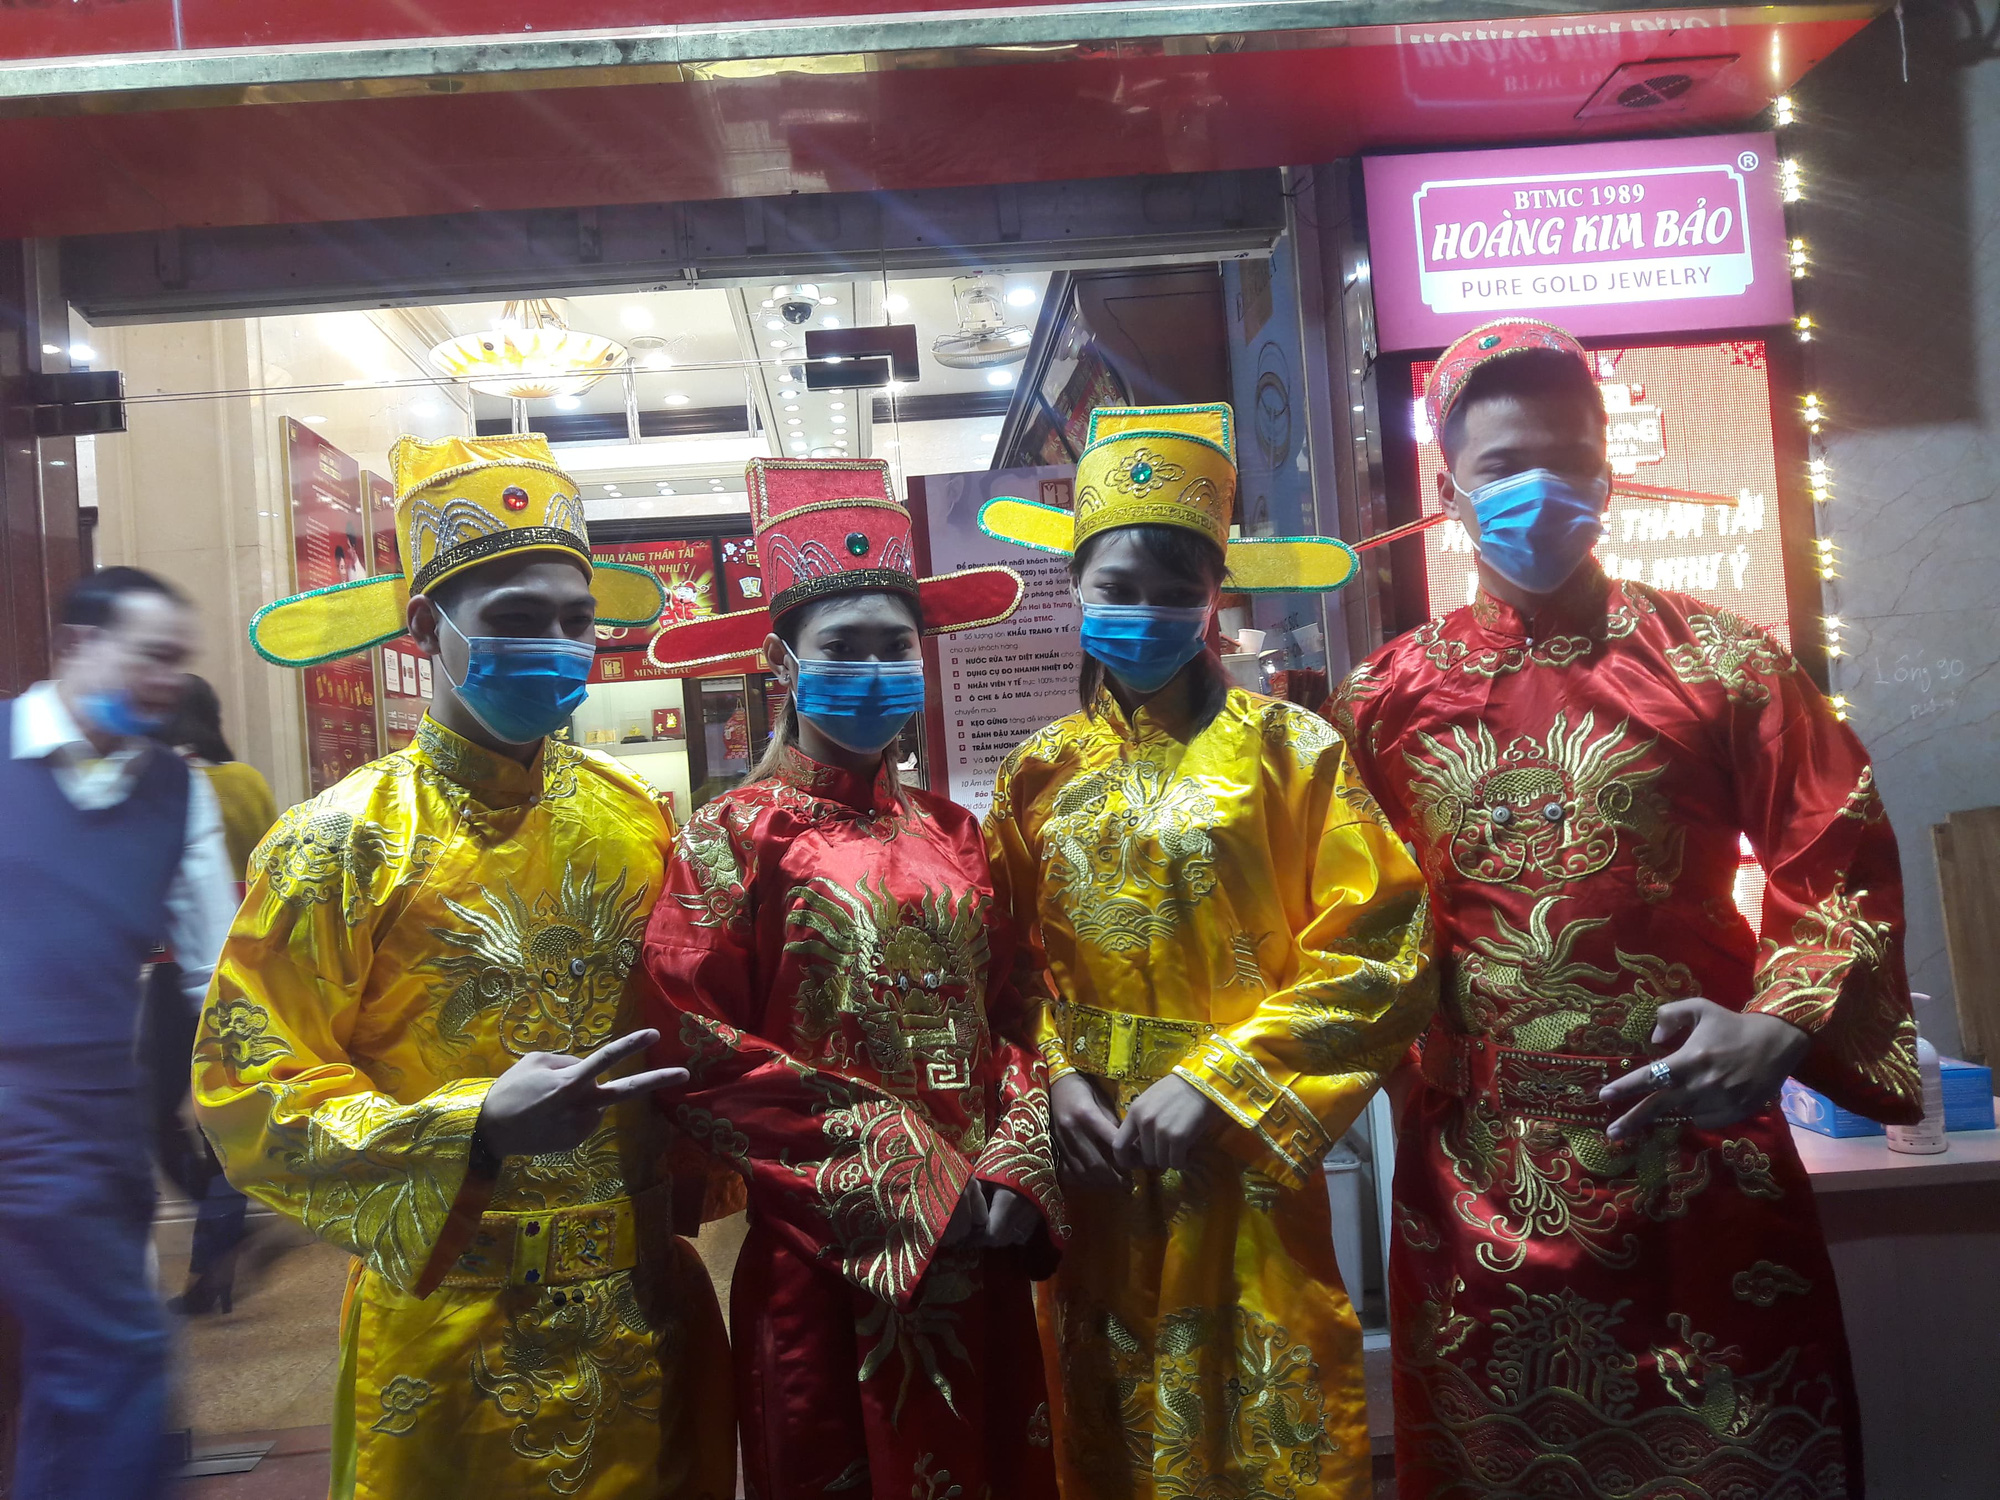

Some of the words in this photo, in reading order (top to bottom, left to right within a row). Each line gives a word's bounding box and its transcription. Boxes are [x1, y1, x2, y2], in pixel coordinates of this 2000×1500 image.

[1514, 188, 1583, 210] BTMC
[1590, 183, 1645, 206] 1989
[1431, 209, 1566, 261] HOÀNG
[1571, 212, 1645, 254] KIM
[1653, 197, 1733, 249] BẢO
[1462, 278, 1523, 298] PURE
[1532, 274, 1598, 293] GOLD
[1607, 266, 1712, 290] JEWELRY
[618, 551, 645, 562] VÀNG
[678, 547, 694, 559] TÀI
[1026, 557, 1049, 565] khách
[1028, 627, 1052, 637] TRANG
[1004, 654, 1017, 662] TAY
[1014, 665, 1041, 674] NHANH
[977, 693, 992, 702] CHE
[1010, 728, 1031, 738] XANH
